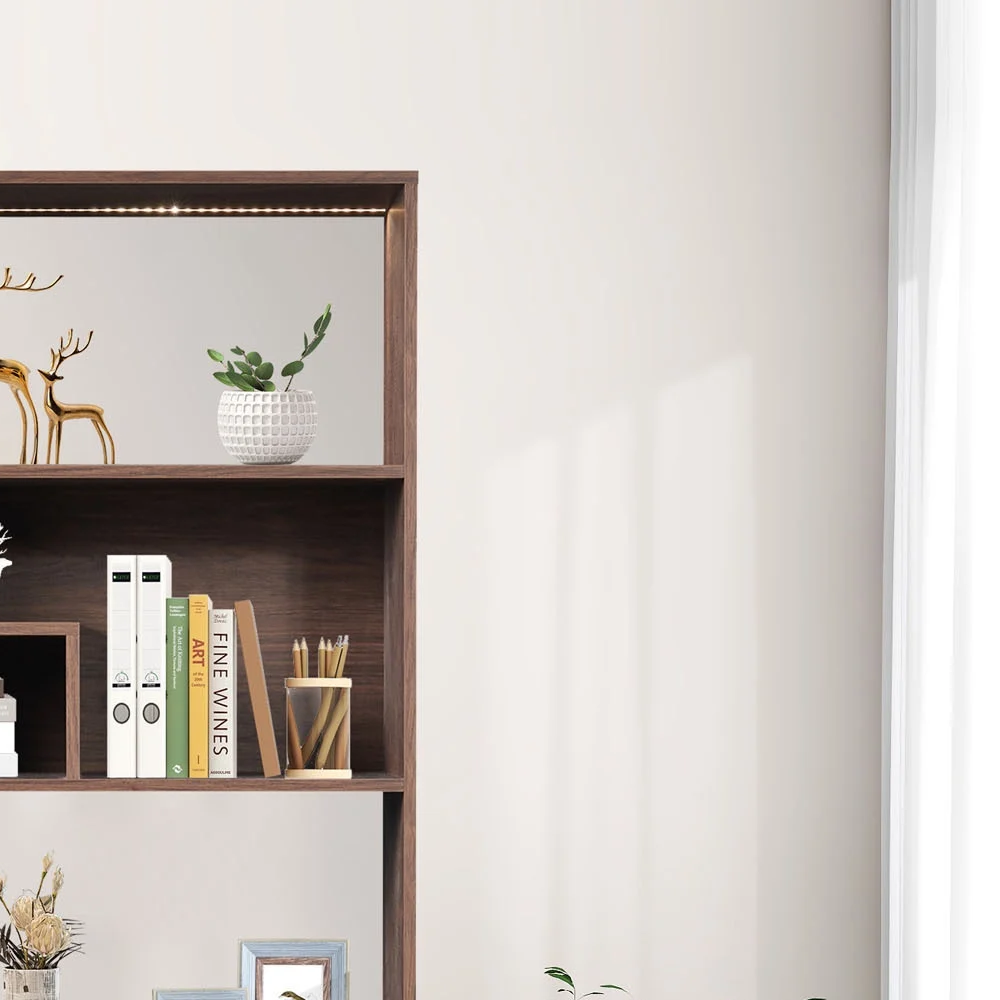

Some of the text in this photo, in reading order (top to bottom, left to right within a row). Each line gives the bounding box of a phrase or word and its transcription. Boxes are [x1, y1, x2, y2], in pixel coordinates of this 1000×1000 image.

[192, 638, 205, 667] ART
[213, 633, 229, 756] FINE WINES
